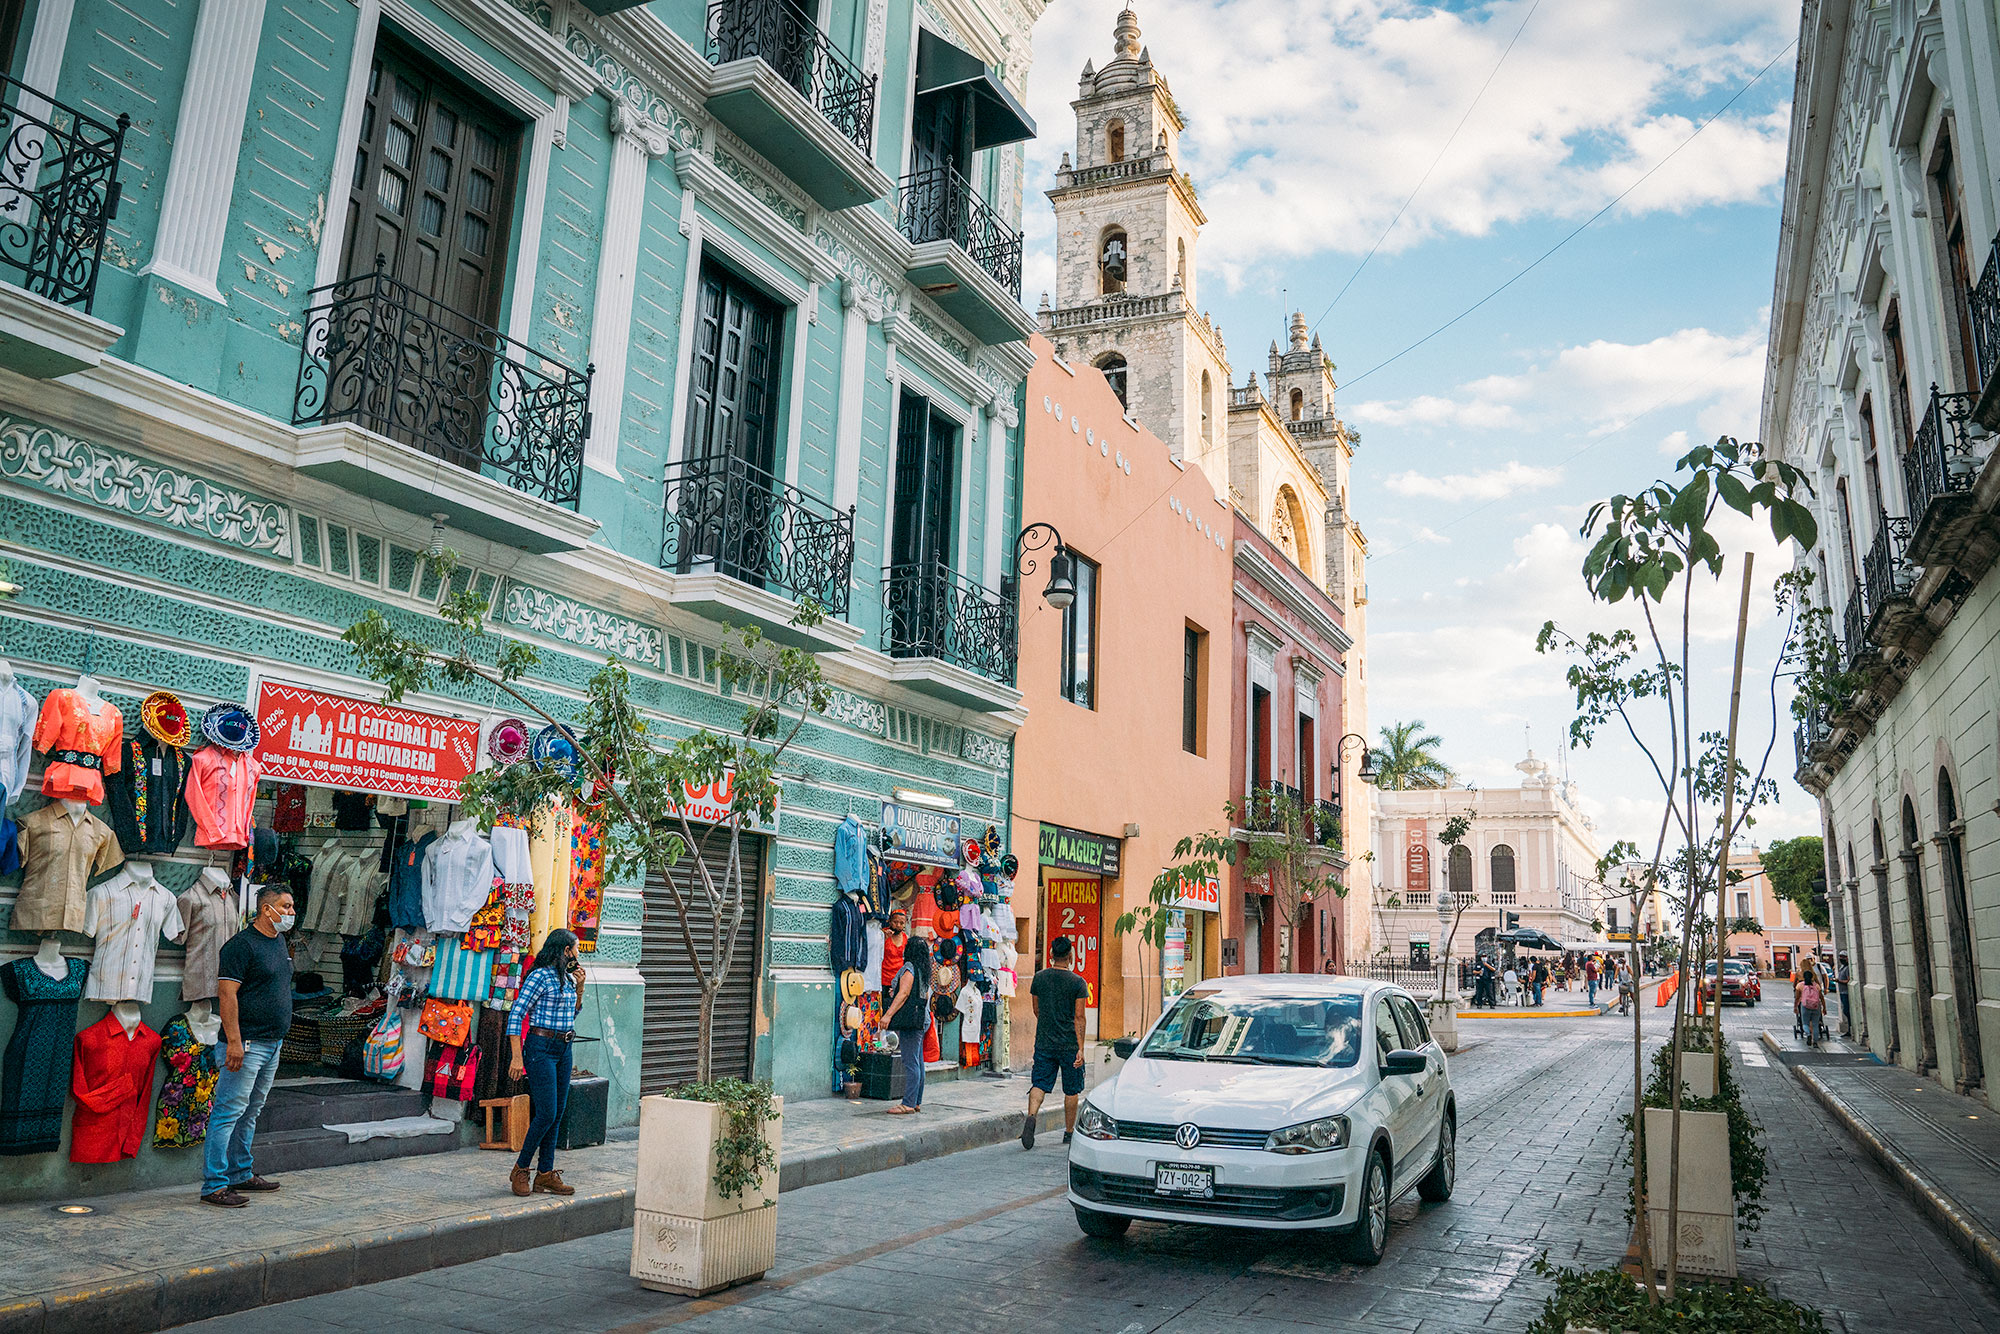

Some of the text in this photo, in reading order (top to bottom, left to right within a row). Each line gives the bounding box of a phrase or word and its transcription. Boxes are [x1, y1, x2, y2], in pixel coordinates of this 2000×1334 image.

[262, 707, 284, 729] 100%
[268, 719, 287, 737] Lino
[338, 712, 447, 750] LA CATEDRAL DE
[335, 737, 436, 772] LA GUAYABERA
[452, 737, 472, 772] Algodón
[461, 737, 475, 761] 100%
[262, 752, 285, 764] Calle
[286, 755, 297, 766] 60
[299, 757, 311, 768] No.
[313, 760, 329, 771] 498
[330, 763, 351, 774] entre
[352, 765, 363, 776] 59
[364, 768, 369, 777] y
[370, 767, 379, 777] 61
[380, 769, 405, 782] Centro
[406, 773, 420, 784] Cel:
[420, 775, 439, 787] 9992
[440, 778, 449, 788] 23
[449, 780, 458, 789] 73
[684, 803, 748, 826] YUCAT
[897, 807, 947, 834] UNIVERSO
[905, 829, 937, 852] MAYA
[1039, 829, 1103, 866] OK MAGUEY
[1410, 829, 1423, 873] MUSEO
[1050, 881, 1097, 904] PLAYERAS
[1164, 872, 1217, 903] OURS
[1061, 907, 1075, 928] 2
[1676, 1254, 1715, 1264] ucatán
